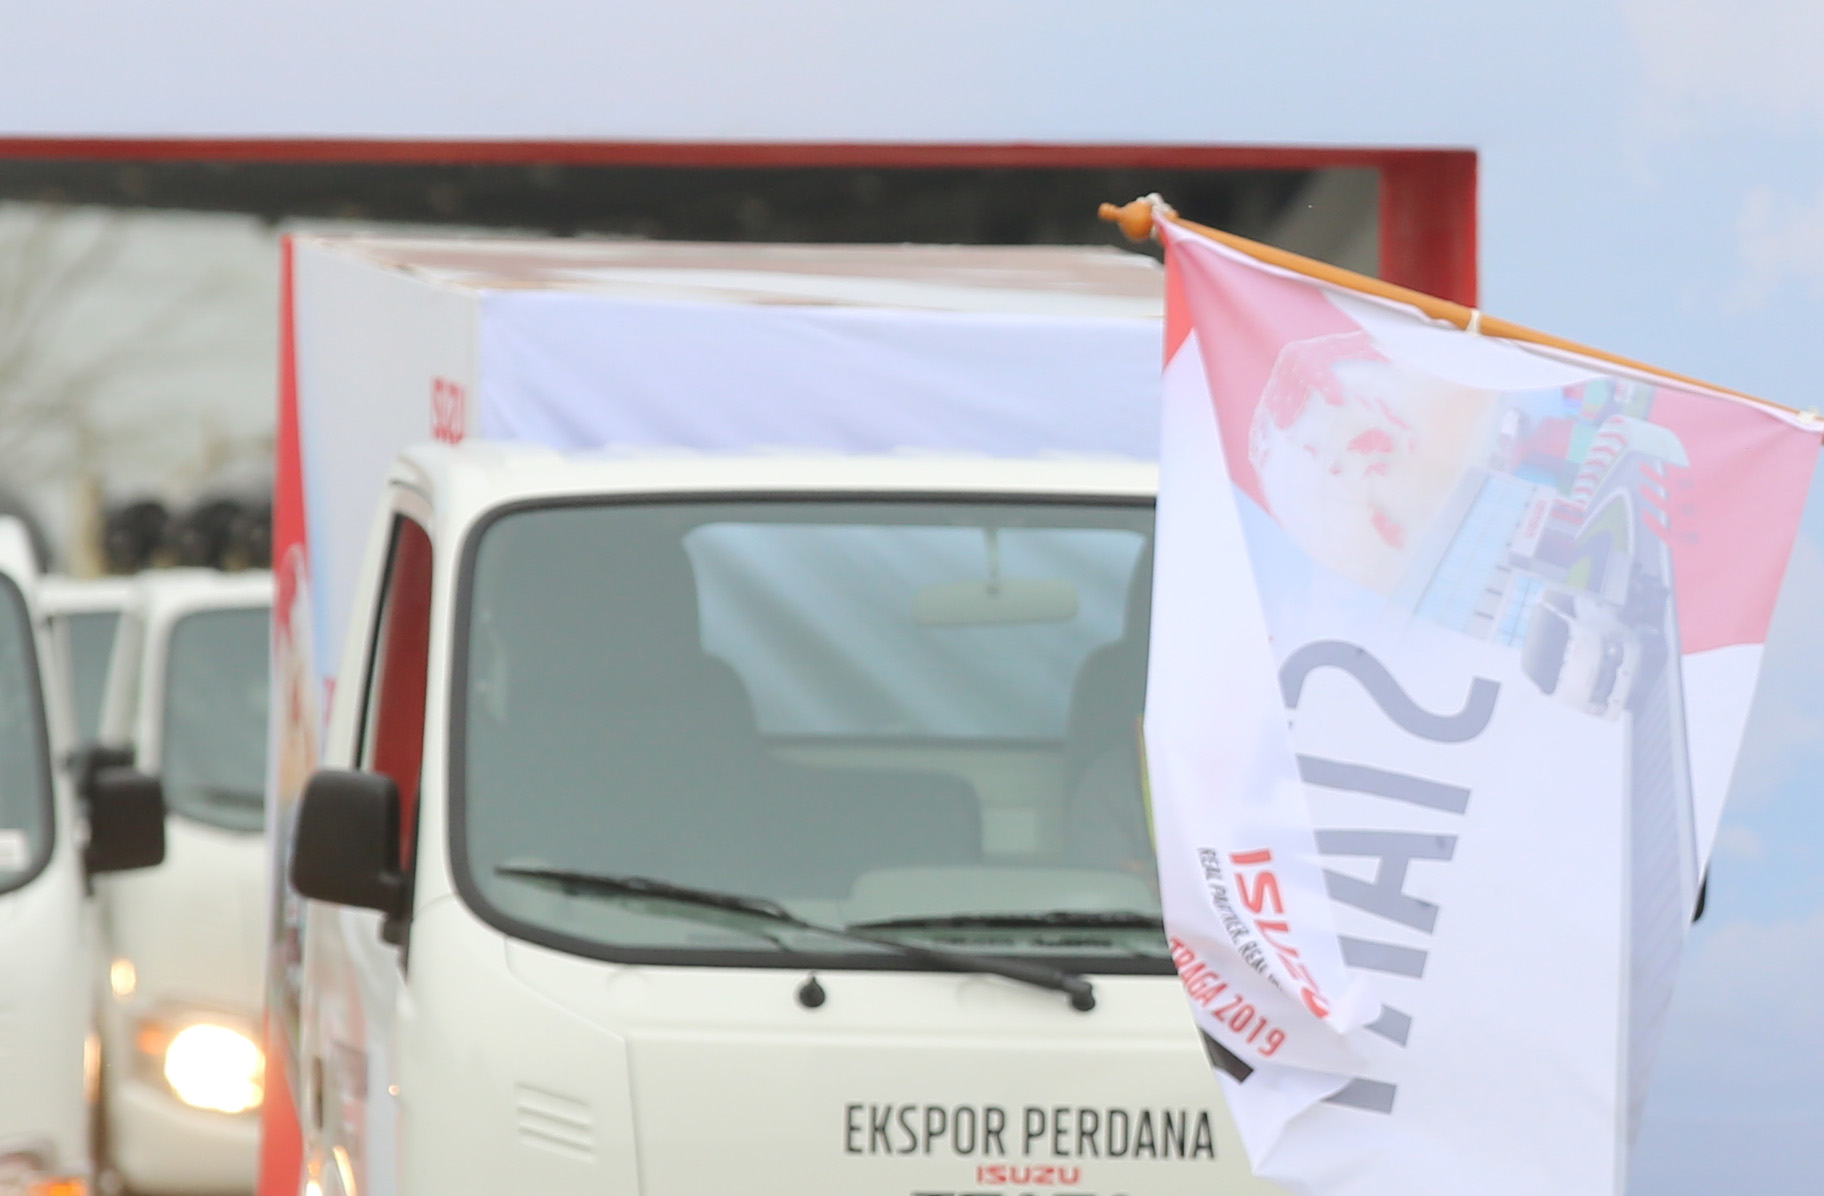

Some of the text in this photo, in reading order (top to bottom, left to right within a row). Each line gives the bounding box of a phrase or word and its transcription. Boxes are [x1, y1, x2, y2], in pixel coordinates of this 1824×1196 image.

[1169, 936, 1287, 1058] TRAGA 2019
[844, 1104, 1216, 1159] EKSPOR PERDANA
[977, 1165, 1082, 1185] ISUZU
